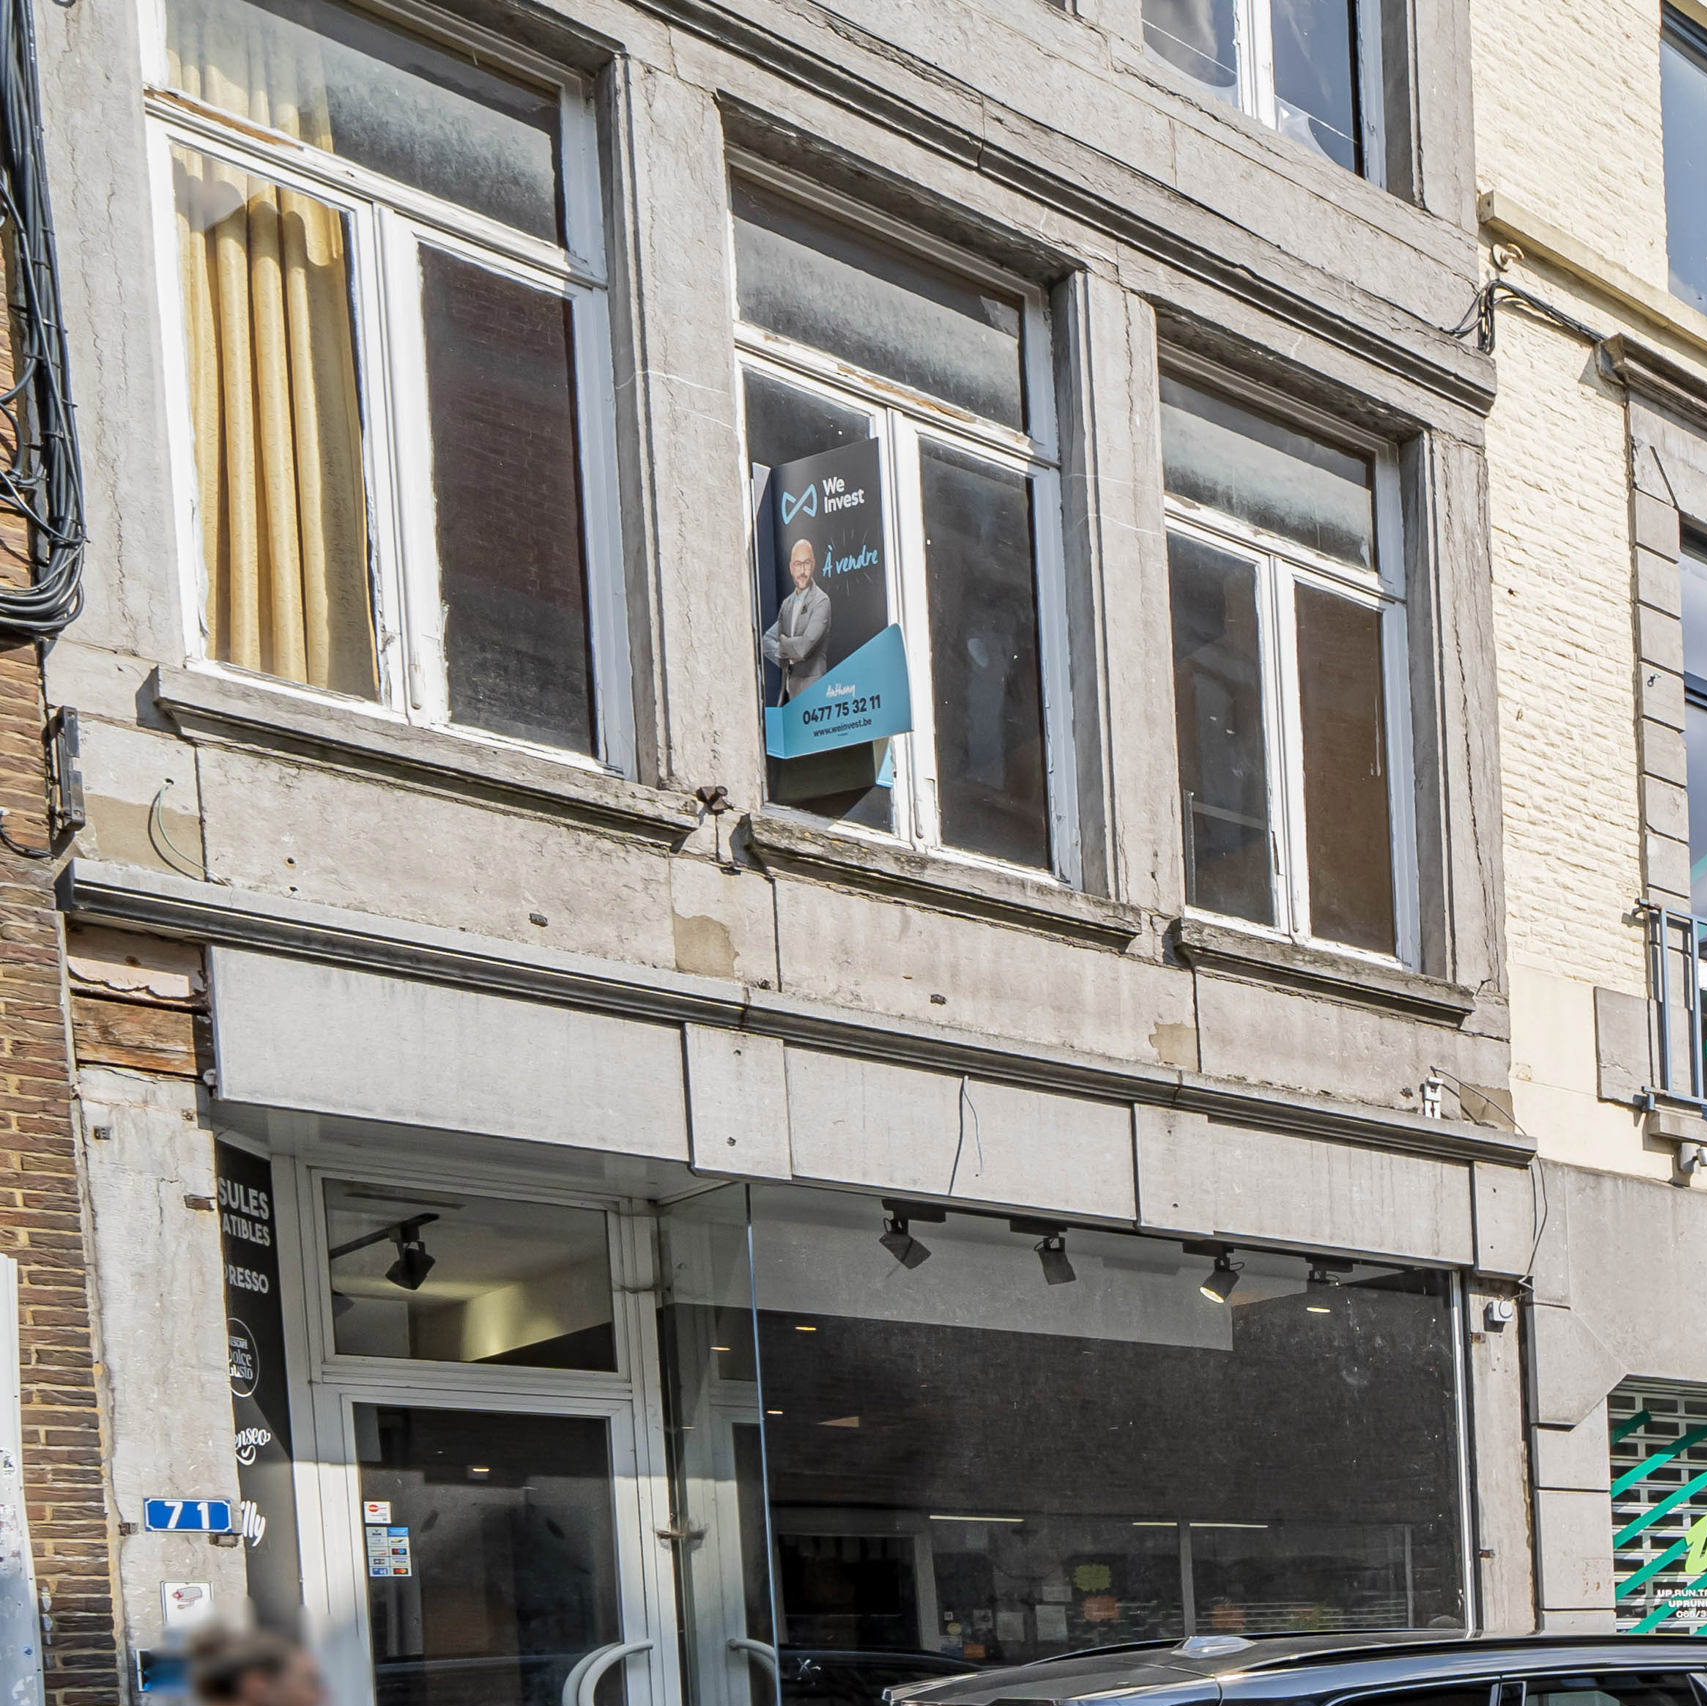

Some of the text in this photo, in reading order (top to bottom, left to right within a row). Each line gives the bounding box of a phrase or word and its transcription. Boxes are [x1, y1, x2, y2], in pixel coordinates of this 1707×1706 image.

[822, 476, 845, 496] We
[824, 488, 865, 514] Invest
[822, 544, 879, 578] À vendre
[802, 694, 881, 725] 0477 75 32 11
[813, 717, 872, 737] www.weinvest.be
[164, 1501, 211, 1530] 71
